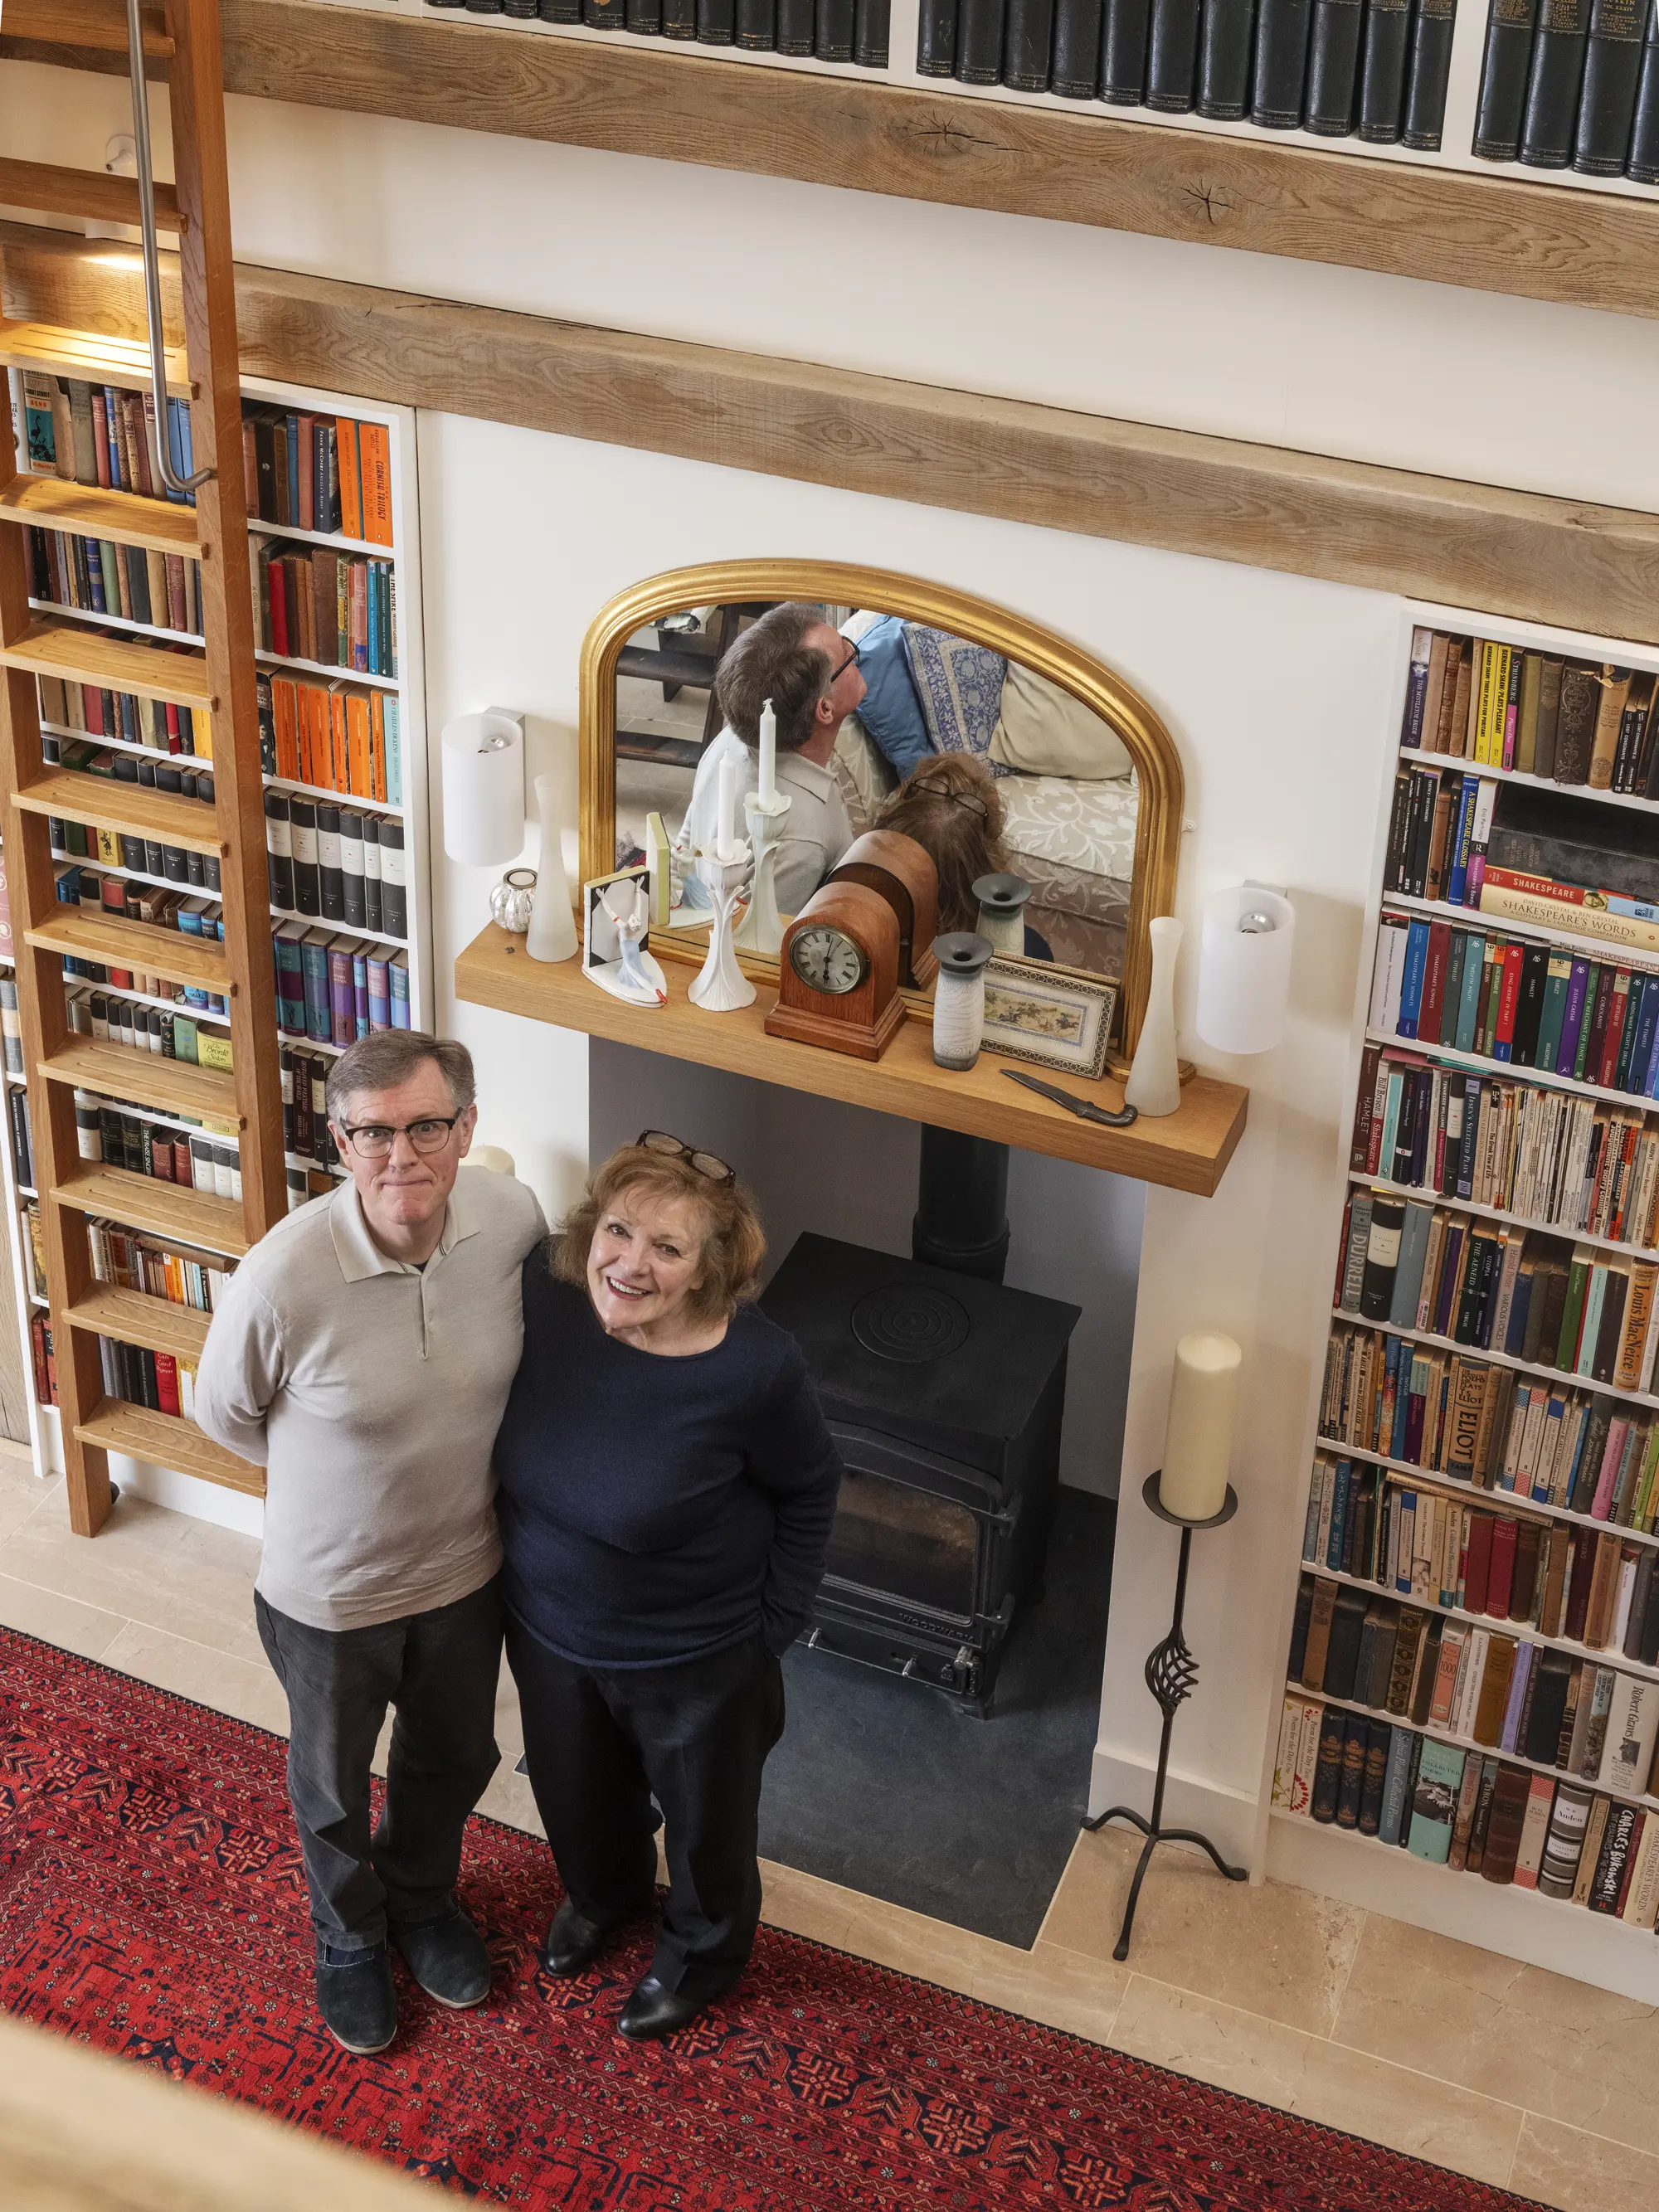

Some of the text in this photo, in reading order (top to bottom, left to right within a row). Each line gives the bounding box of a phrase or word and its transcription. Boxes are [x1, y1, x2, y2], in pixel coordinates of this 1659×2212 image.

[30, 400, 46, 408] BENN
[375, 460, 387, 521] CORNISH TRILOGY
[1510, 659, 1520, 701] STRINDBERG
[1463, 798, 1475, 838] SHAKESPEARE
[1478, 819, 1486, 839] Partridge
[1460, 838, 1470, 868] GLOSSARY
[1468, 891, 1477, 906] Bawdy
[1513, 878, 1574, 899] SHAKESPEARE
[1502, 900, 1637, 938] SHAKESPEARE'S WORDS
[1523, 898, 1543, 907] DAVID
[1545, 904, 1571, 914] CRYSTAL
[1593, 914, 1618, 924] CRYSTAL
[1515, 912, 1545, 922] GLOSSARY
[1588, 926, 1627, 941] COMPANION
[1593, 949, 1656, 970] SHAKESPEAREAN
[1583, 1005, 1592, 1034] MERCHANT
[1596, 996, 1607, 1028] CORIOLANUS
[1627, 1001, 1636, 1029] MIDSUMMER
[1578, 1043, 1586, 1062] VENICE
[1641, 1029, 1650, 1048] TEMPEST
[1374, 1077, 1387, 1112] Bill Bryson
[1360, 1096, 1372, 1134] HAMLET
[1368, 1122, 1381, 1163] Shakespeare
[1647, 1192, 1658, 1228] MONOLOGUES
[1345, 1233, 1368, 1296] DURRELL
[1468, 1242, 1481, 1286] THE AENEID
[1484, 1256, 1492, 1277] UTOPIA
[1504, 1249, 1518, 1288] Harold Pinter
[1496, 1294, 1510, 1341] VARIOUS VOICES
[1623, 1283, 1650, 1369] Louis MacNeice
[1459, 1393, 1483, 1403] ELIOT
[1455, 1411, 1477, 1460] ELIOT
[1546, 1485, 1555, 1505] FABER
[1391, 1501, 1399, 1532] TENNYSON
[1609, 1503, 1618, 1522] FABER
[1440, 1660, 1457, 1675] 1000
[1625, 1685, 1645, 1738] Robert Graves
[1387, 1728, 1408, 1829] Sylvia Plath Collected Poems
[1481, 1784, 1491, 1807] BYRON
[1558, 1811, 1583, 1823] Auden
[1613, 1810, 1634, 1850] CHARLES
[1603, 1850, 1626, 1895] BUKOWSKI
[1637, 1884, 1650, 1912] WORDS
